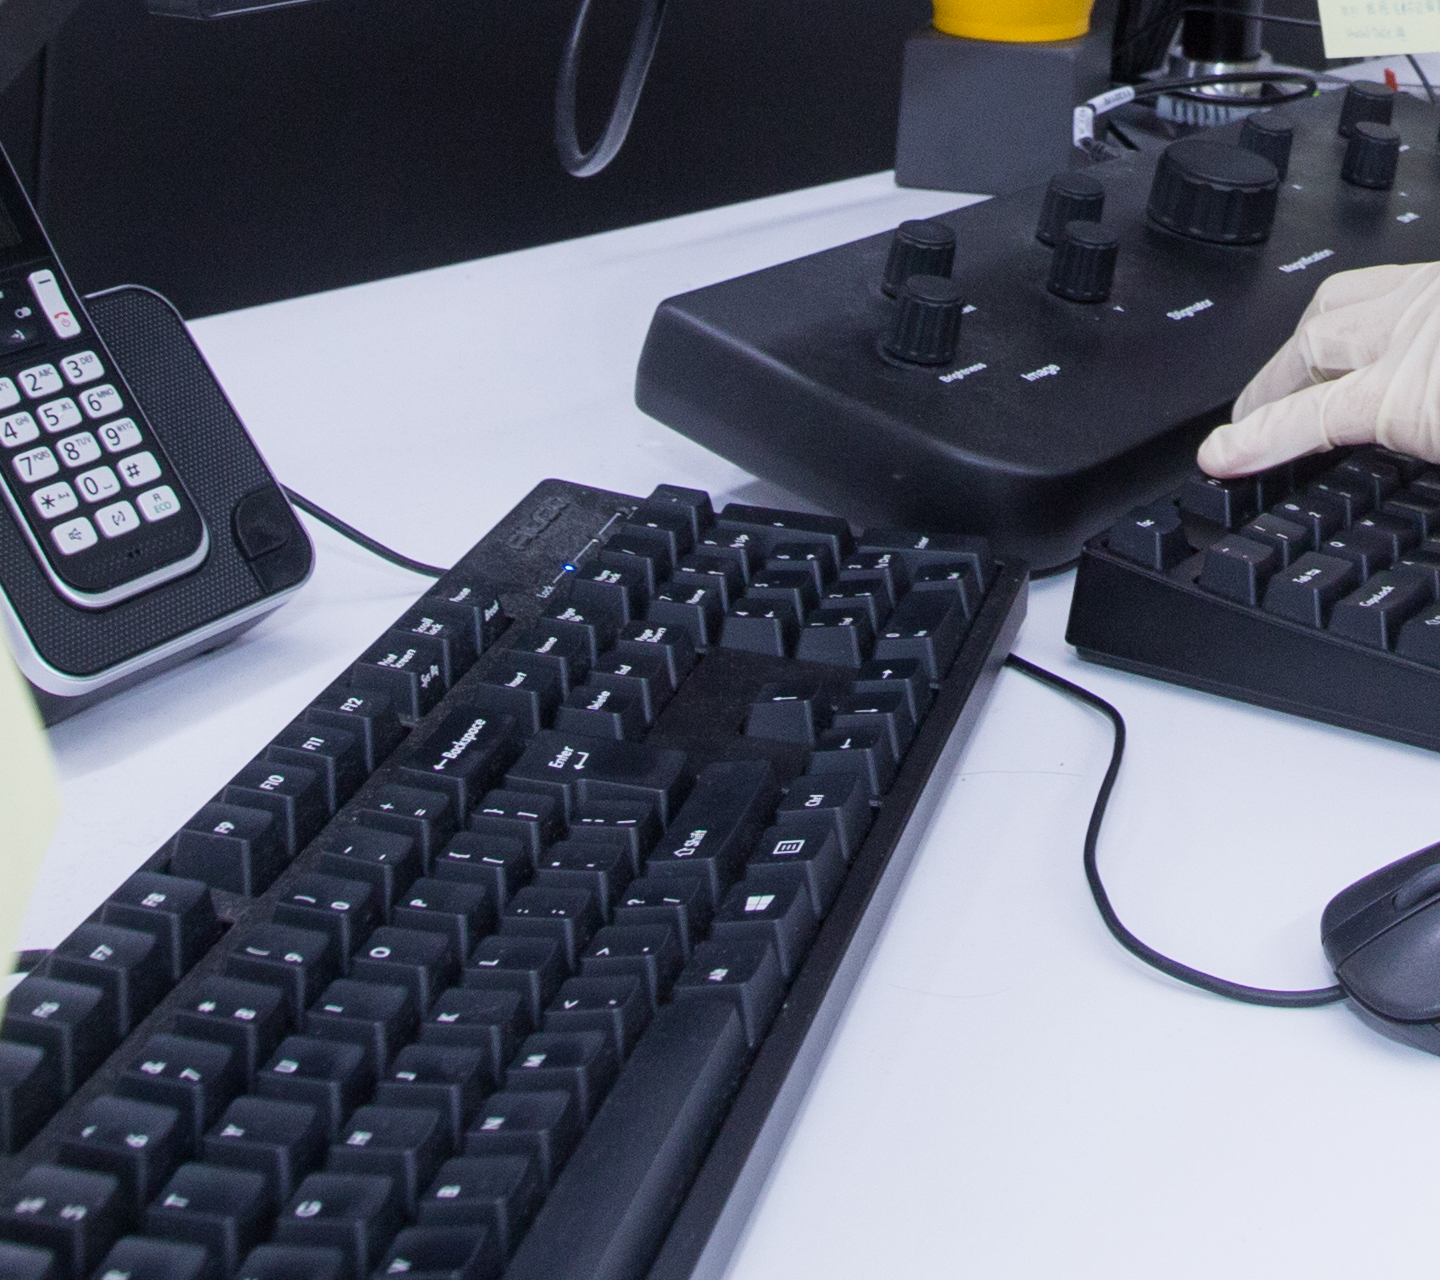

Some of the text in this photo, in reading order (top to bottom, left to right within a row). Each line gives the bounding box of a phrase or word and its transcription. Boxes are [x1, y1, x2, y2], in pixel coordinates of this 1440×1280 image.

[1279, 249, 1333, 272] Magnification
[1167, 299, 1213, 320] Stigmator
[66, 354, 94, 378] 3 DEF
[939, 363, 987, 382] Brightness
[1021, 364, 1060, 381] Image
[24, 373, 42, 392] 2
[38, 368, 54, 378] ABC
[86, 393, 102, 412] 6
[43, 407, 60, 427] 5
[3, 421, 19, 439] 4
[105, 427, 121, 446] 9
[63, 441, 80, 461] 8
[19, 456, 33, 476] 7
[126, 462, 140, 479] #
[83, 476, 99, 496] 0
[153, 501, 172, 514] ECO
[340, 698, 363, 711] F12
[302, 737, 324, 750] F11
[442, 719, 486, 761] Backspace
[548, 746, 576, 769] Enter
[260, 775, 284, 790] F10
[214, 822, 234, 833] F9
[410, 899, 426, 907] P
[482, 1118, 504, 1129] N
